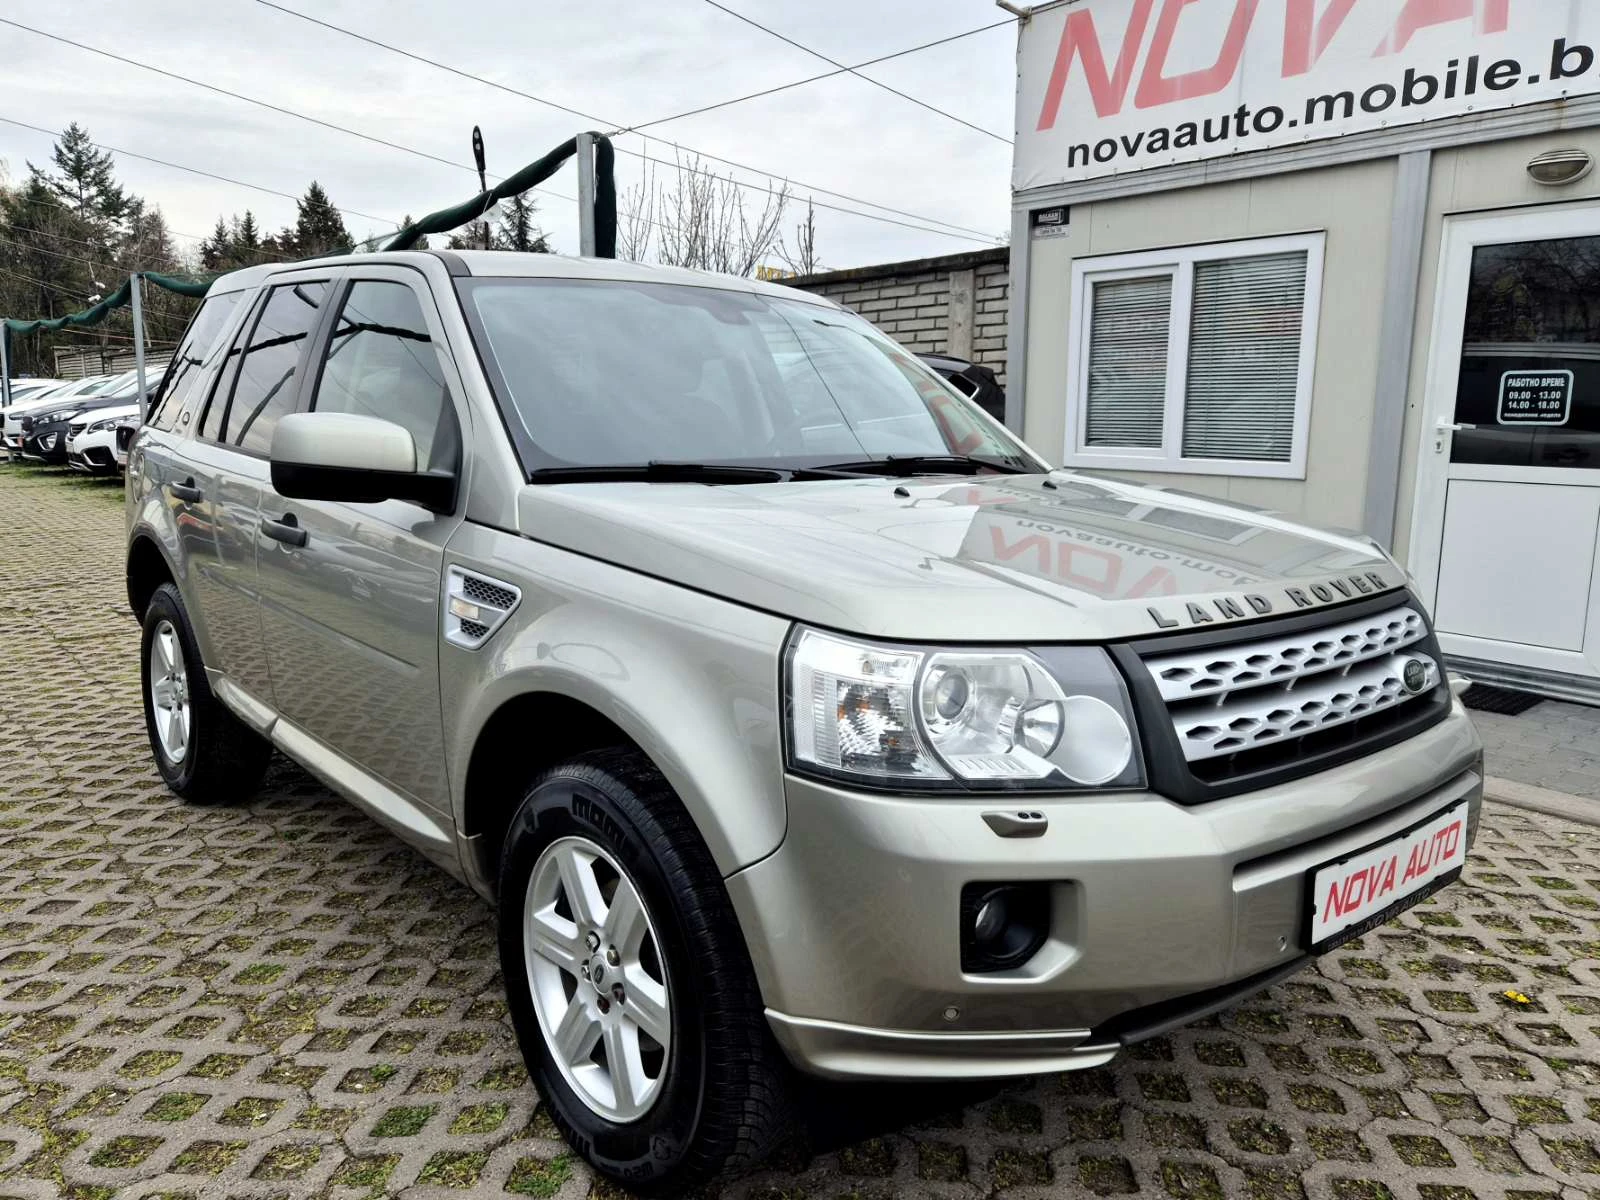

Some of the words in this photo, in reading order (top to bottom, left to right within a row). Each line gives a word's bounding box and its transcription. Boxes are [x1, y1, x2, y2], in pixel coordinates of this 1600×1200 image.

[1067, 37, 1600, 168] novaauto.mobile.b
[1507, 378, 1540, 387] РАБОТНО
[1541, 378, 1565, 387] ВРЕМЕ
[1508, 391, 1531, 399] 09.00
[1539, 391, 1561, 399] 13.00
[1508, 401, 1530, 409] 14.00
[1537, 401, 1560, 409] 18.00
[1147, 594, 1273, 629] LAND
[1285, 571, 1387, 607] ROVER
[1322, 855, 1398, 923] NOVA
[1401, 820, 1462, 885] AUTO
